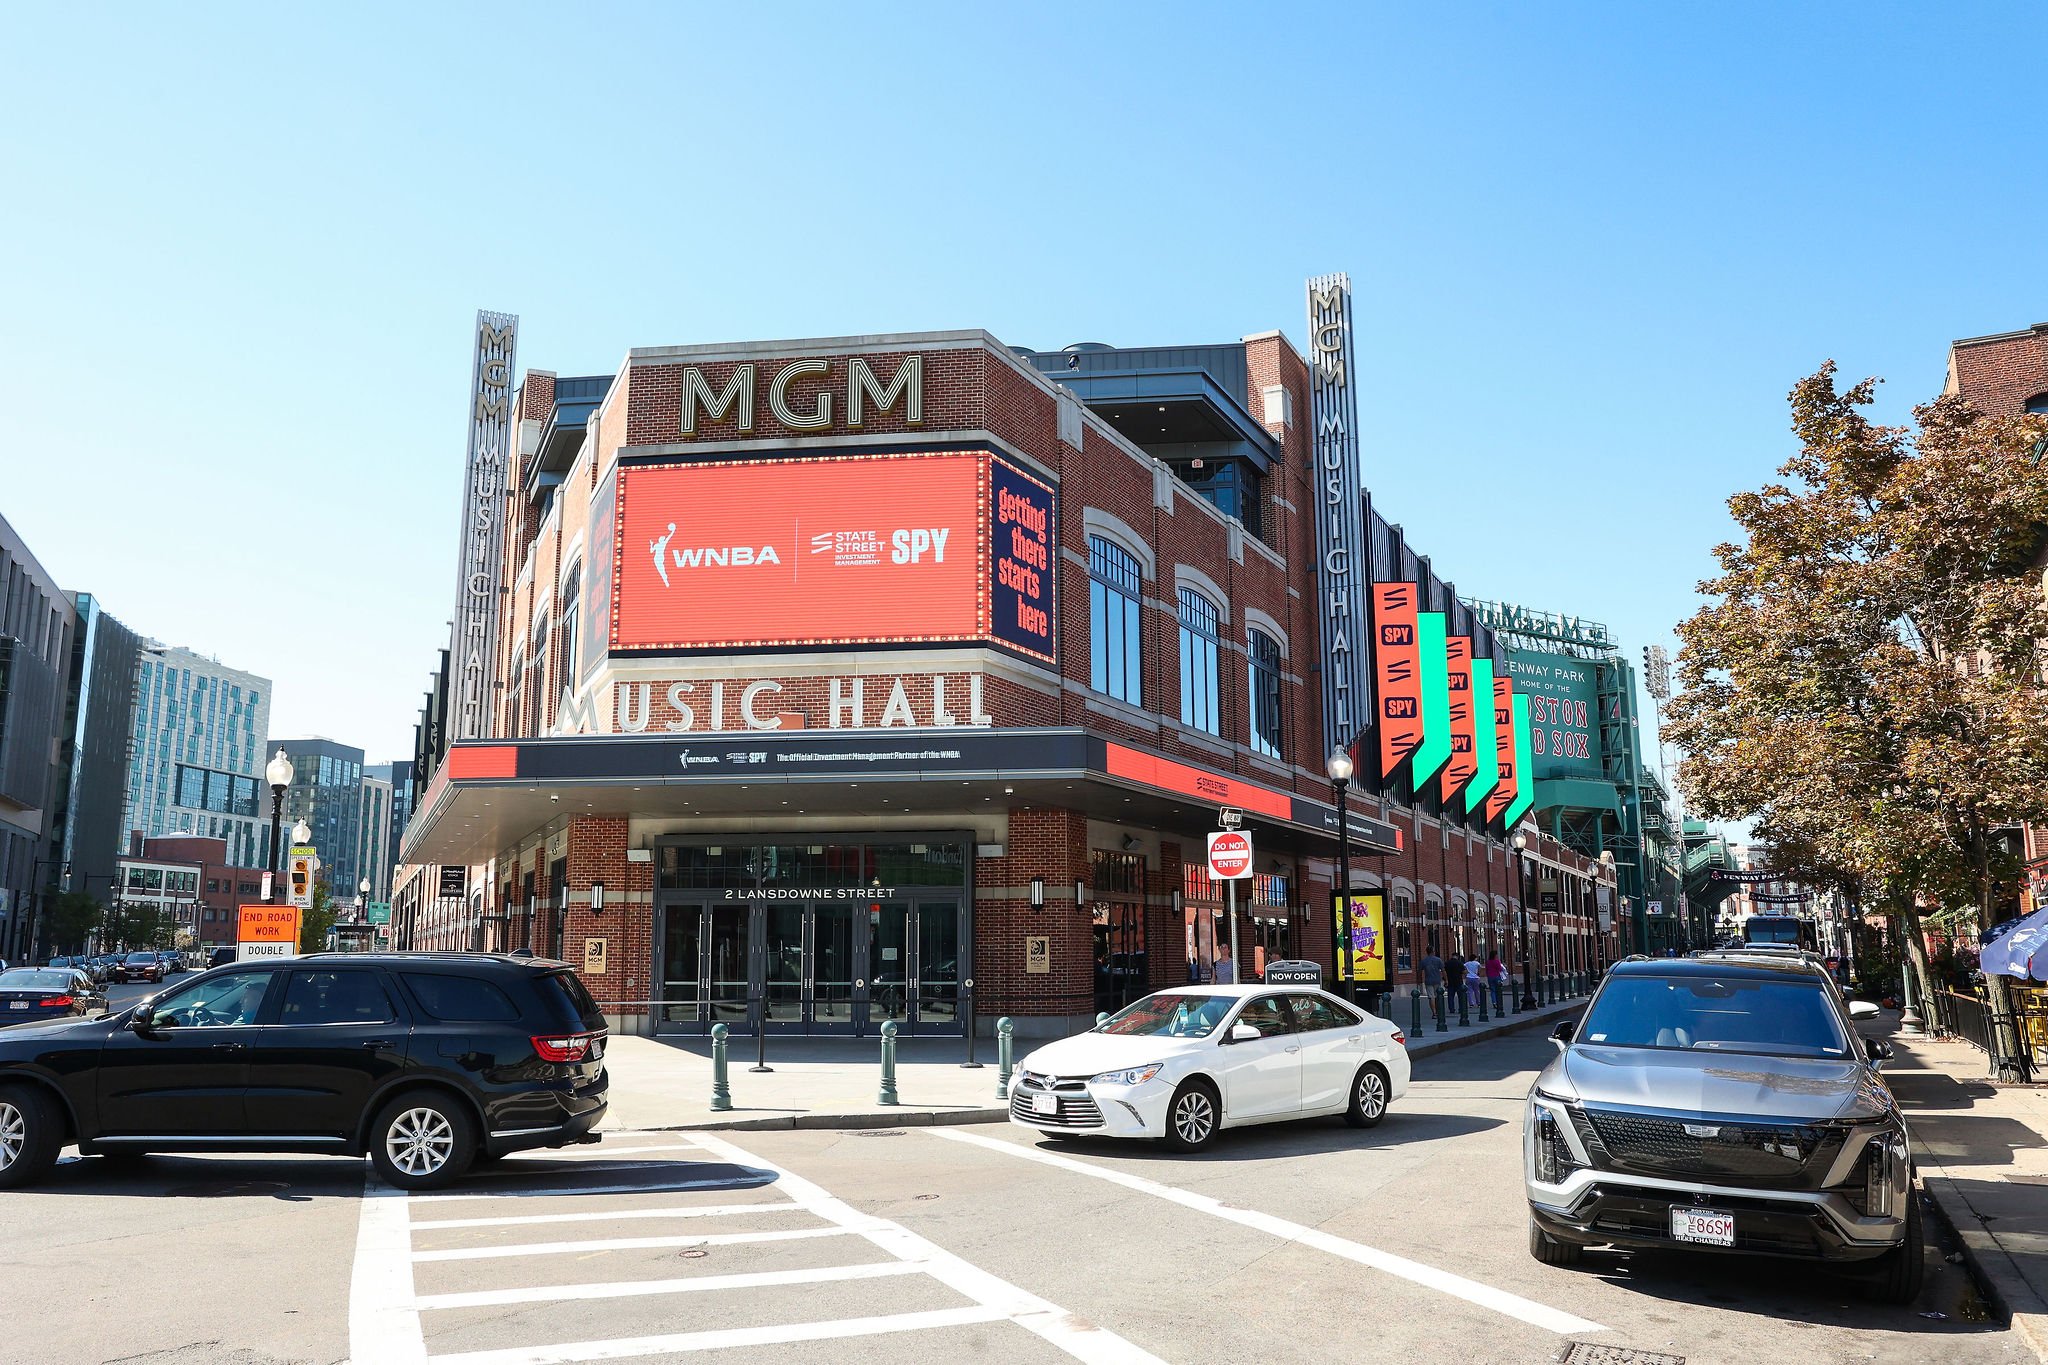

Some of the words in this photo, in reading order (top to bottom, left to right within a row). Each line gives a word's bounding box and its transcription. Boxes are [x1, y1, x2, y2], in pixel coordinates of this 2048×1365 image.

[1309, 285, 1345, 391] MGM
[475, 321, 512, 424] MGM
[680, 354, 925, 436] MGM
[1319, 411, 1349, 575] MUSIC
[468, 443, 500, 597] MUSIC
[998, 487, 1047, 544] getting
[835, 531, 876, 542] STATE
[835, 541, 886, 552] STREET
[892, 528, 950, 565] SPY
[1011, 526, 1047, 571] there
[672, 546, 781, 568] WNBA
[998, 557, 1040, 599] starts
[1017, 594, 1048, 638] here
[1384, 628, 1410, 643] SPY
[1329, 590, 1350, 726] HALL
[464, 611, 487, 738] HALL
[1555, 669, 1585, 682] PARK
[1520, 680, 1541, 689] HOME
[1557, 685, 1571, 693] THE
[553, 680, 783, 734] MUSIC
[829, 675, 993, 728] HALL
[1388, 700, 1413, 716] SPY
[1528, 694, 1588, 728] STON
[1495, 710, 1507, 723] PY
[1552, 729, 1590, 759] SOX
[748, 752, 768, 764] SPY
[776, 753, 789, 761] The
[789, 753, 813, 761] Official
[813, 753, 851, 761] Investment
[852, 752, 894, 762] Management
[1497, 764, 1510, 777] PY
[1214, 842, 1226, 851] DO
[1229, 842, 1245, 850] NOT
[1217, 860, 1243, 868] ENTER
[725, 890, 734, 899] 2
[738, 889, 832, 899] LANSDOWNE
[837, 888, 895, 898] STREET
[244, 913, 263, 922] END
[267, 913, 293, 922] ROAD
[255, 927, 280, 936] WORK
[248, 946, 284, 955] DOUBLE
[1696, 1218, 1732, 1237] 86SM
[1675, 1235, 1694, 1243] HERB
[1694, 1237, 1732, 1247] CHAMBERS
